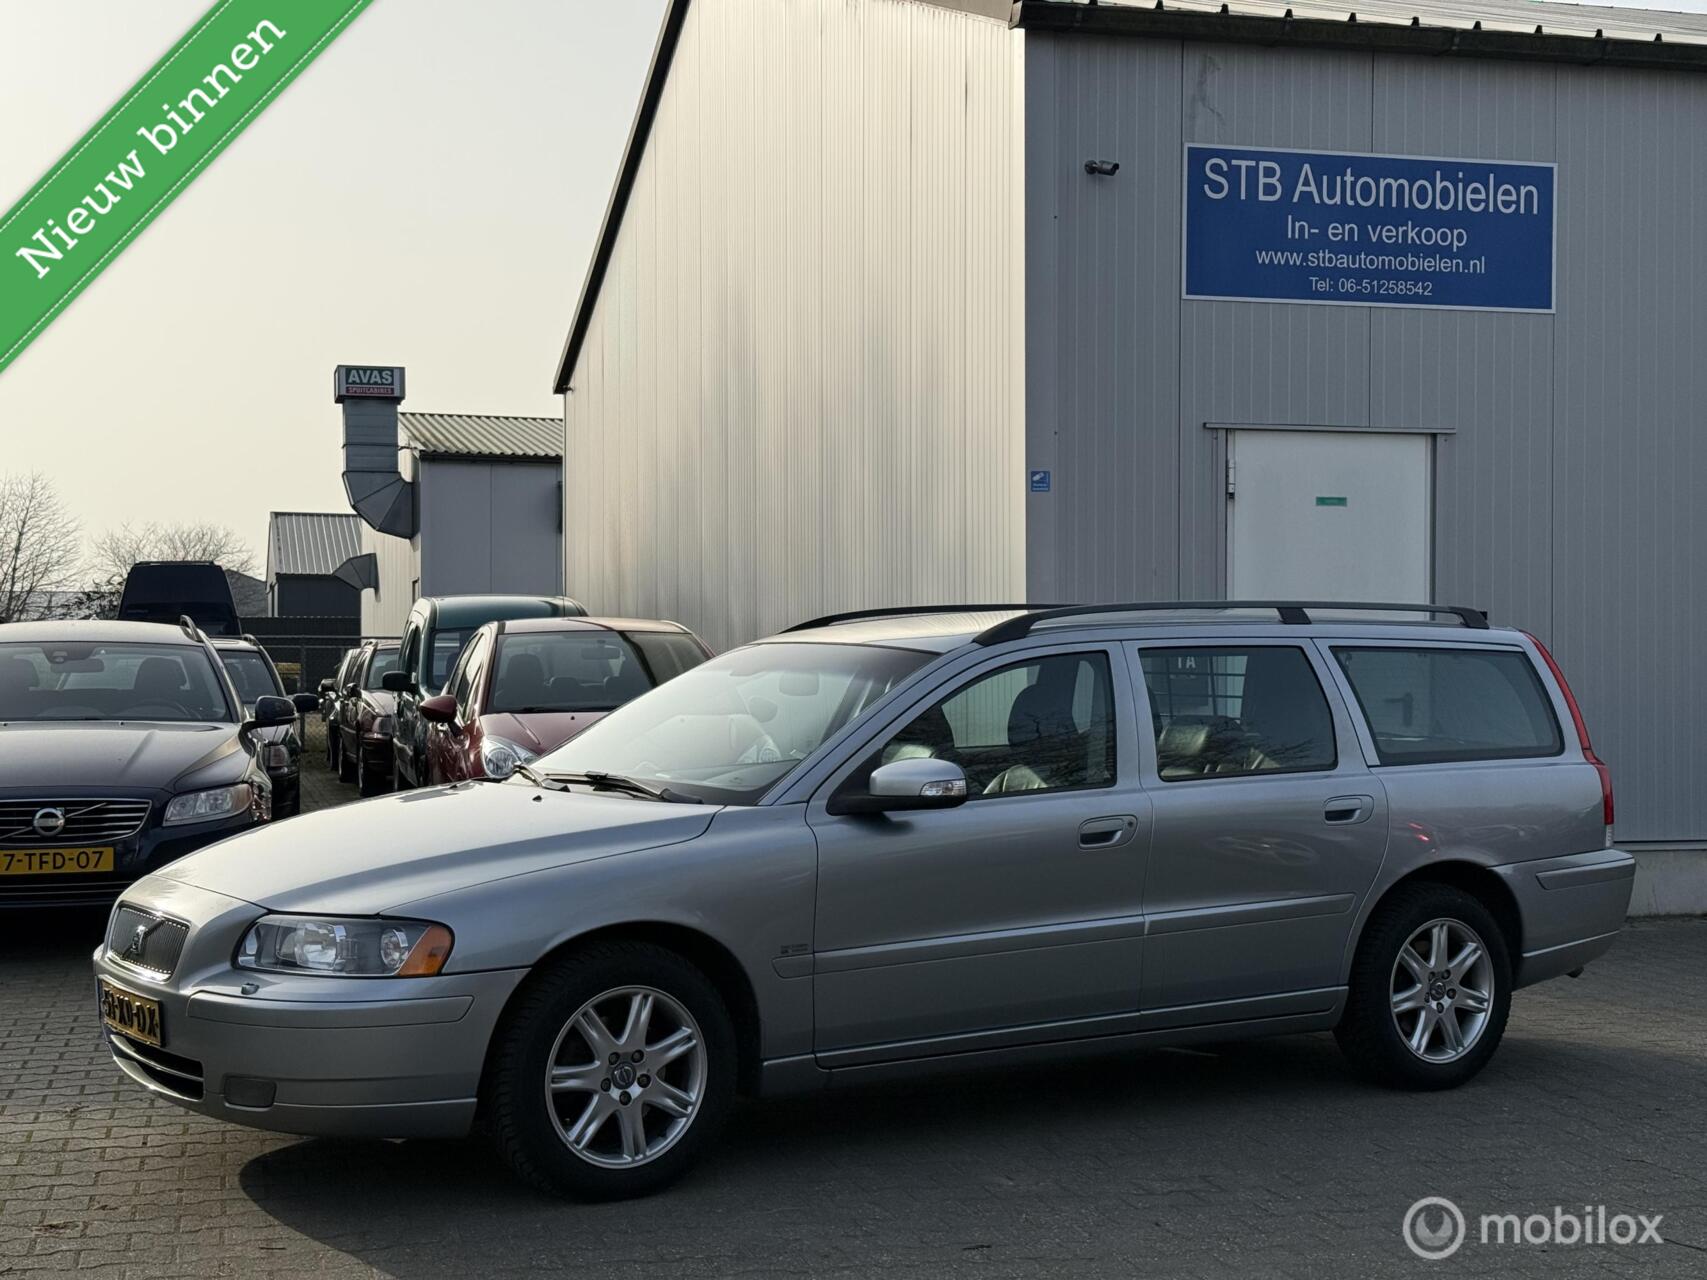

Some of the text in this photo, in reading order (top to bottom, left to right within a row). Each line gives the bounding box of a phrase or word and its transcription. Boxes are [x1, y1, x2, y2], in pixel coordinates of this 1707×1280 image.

[1203, 157, 1539, 215] STB Automobielen
[1287, 215, 1468, 252] In- en verkoop
[1255, 249, 1486, 275] www.stbautomobielen.nl
[1309, 276, 1433, 297] Tel: 06-51258542
[348, 369, 393, 384] AVAS
[3, 850, 105, 871] 7-TFD-07
